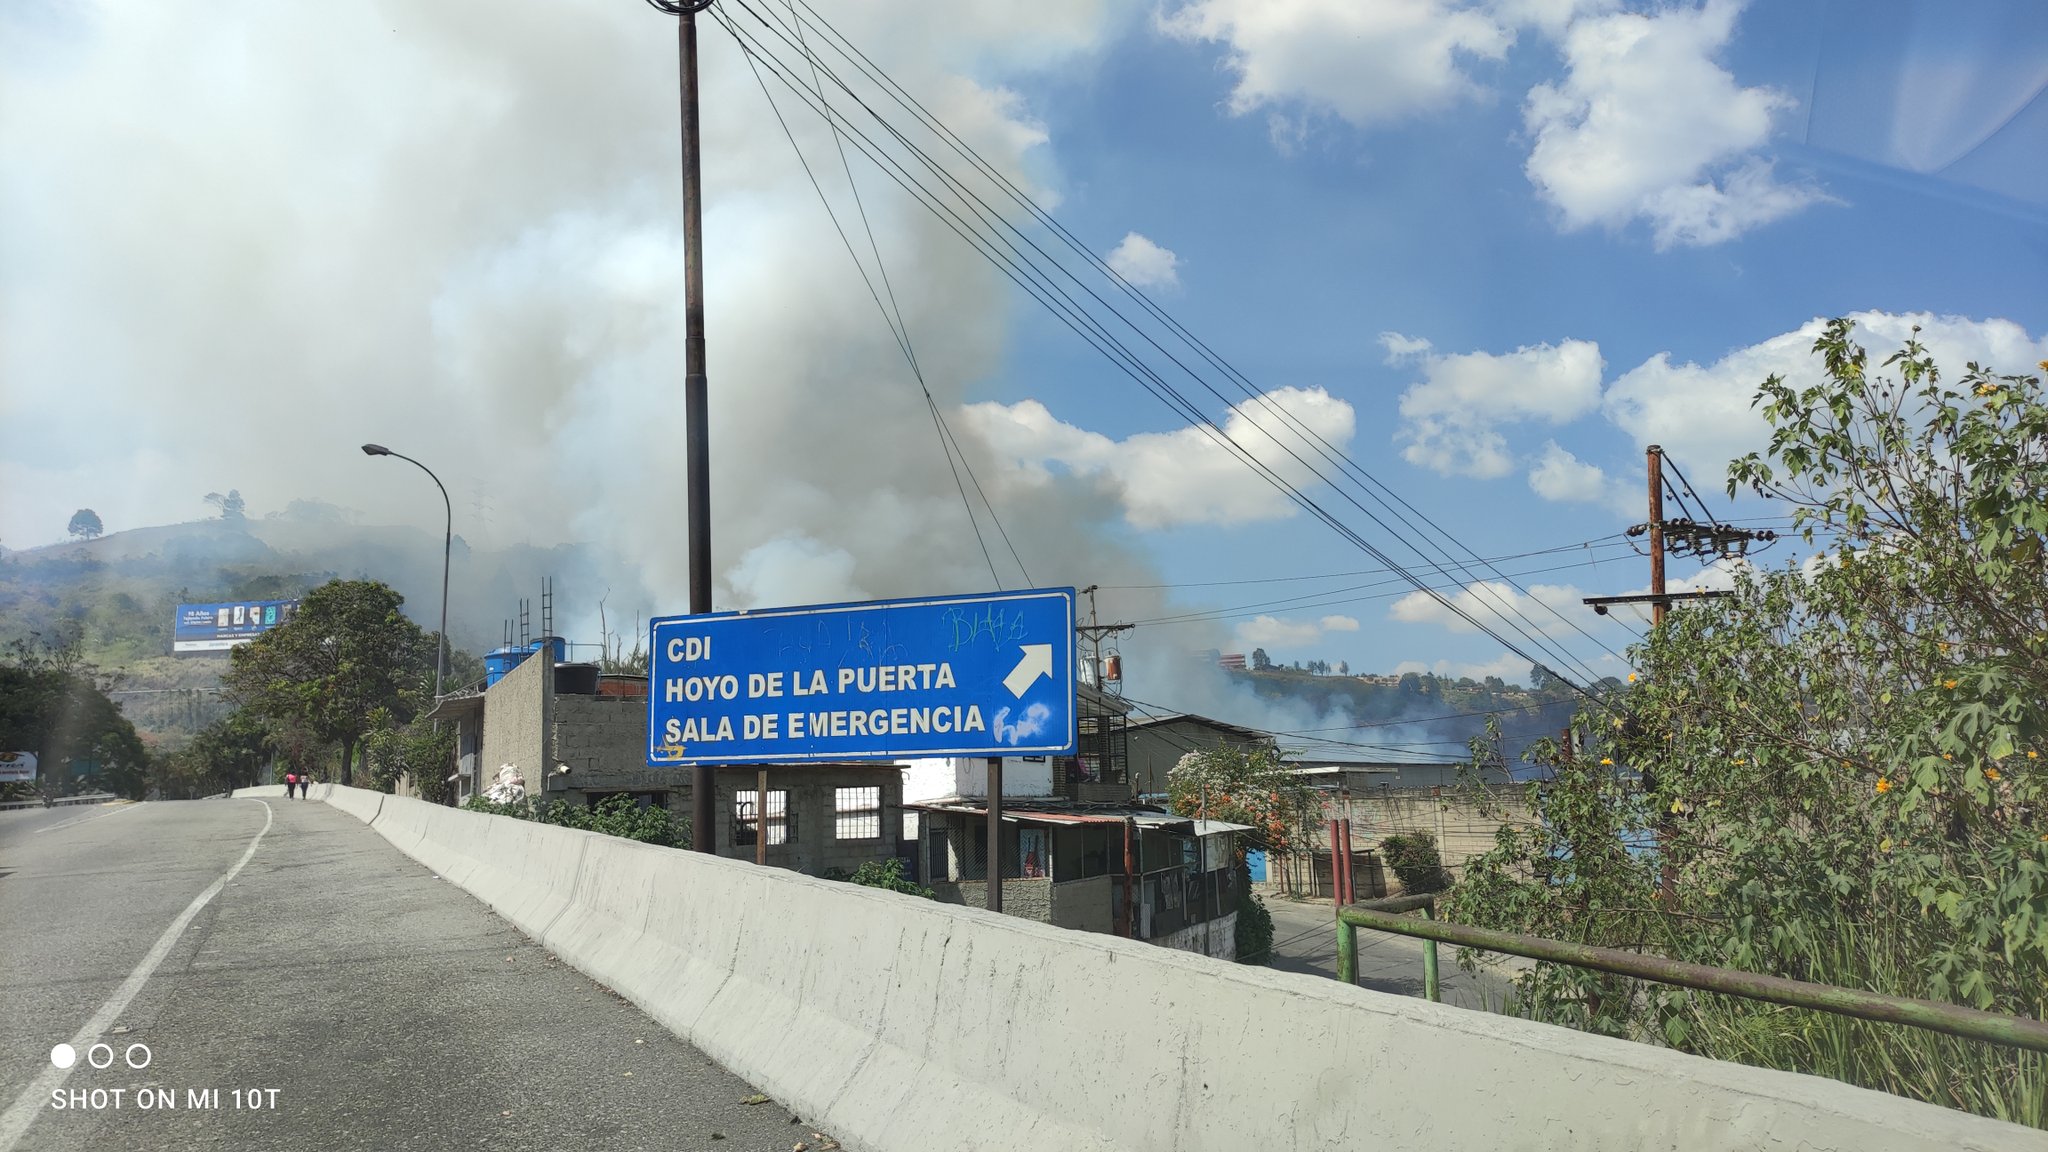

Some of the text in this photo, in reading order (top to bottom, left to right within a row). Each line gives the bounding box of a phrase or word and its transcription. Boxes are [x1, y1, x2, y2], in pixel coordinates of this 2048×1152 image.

[668, 637, 710, 662] CDI
[666, 663, 956, 702] HOYO DE LA PUERTA
[666, 717, 734, 743] SALA
[744, 714, 778, 739] DE
[789, 706, 985, 738] EMERGENCIA
